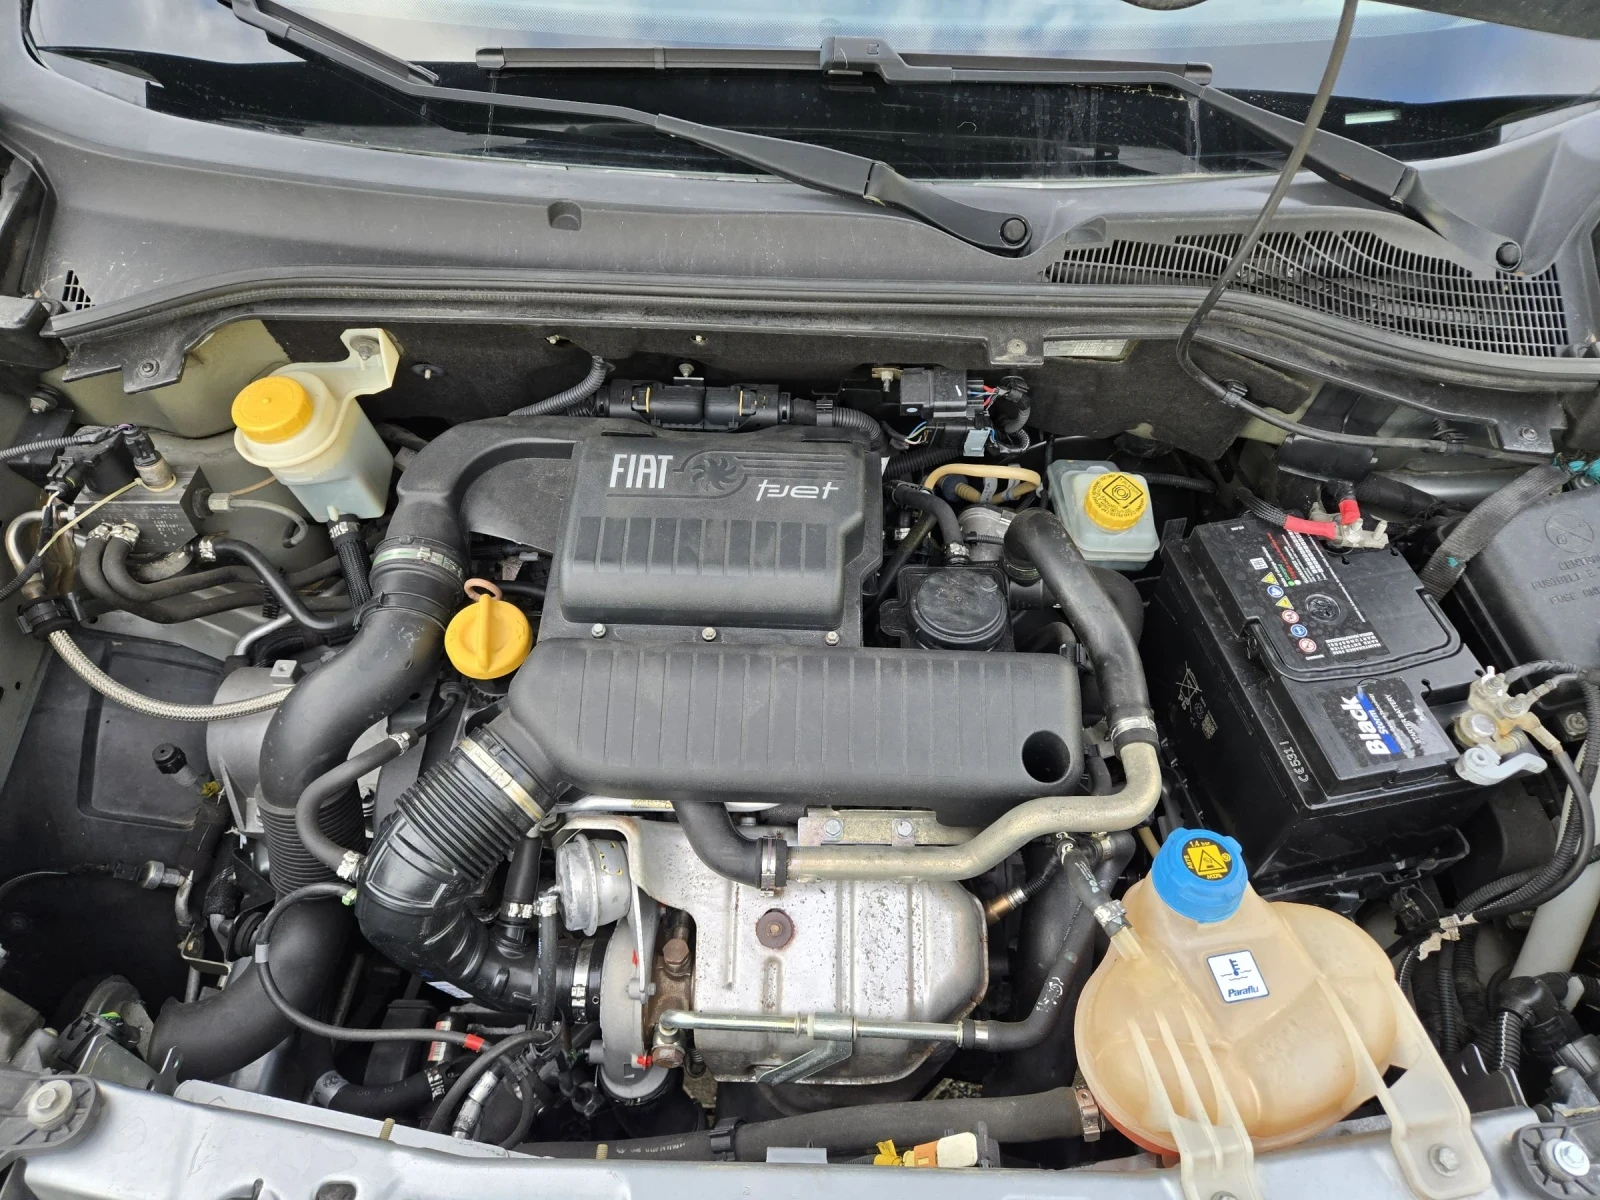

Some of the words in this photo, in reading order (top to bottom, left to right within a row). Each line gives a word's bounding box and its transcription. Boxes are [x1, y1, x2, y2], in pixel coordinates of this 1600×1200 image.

[609, 454, 673, 489] FIAT
[1383, 693, 1404, 718] BATTERY
[1340, 696, 1390, 754] Black
[1367, 709, 1389, 733] Storm
[1400, 719, 1421, 743] STARTER
[1227, 985, 1259, 998] Paraflu
